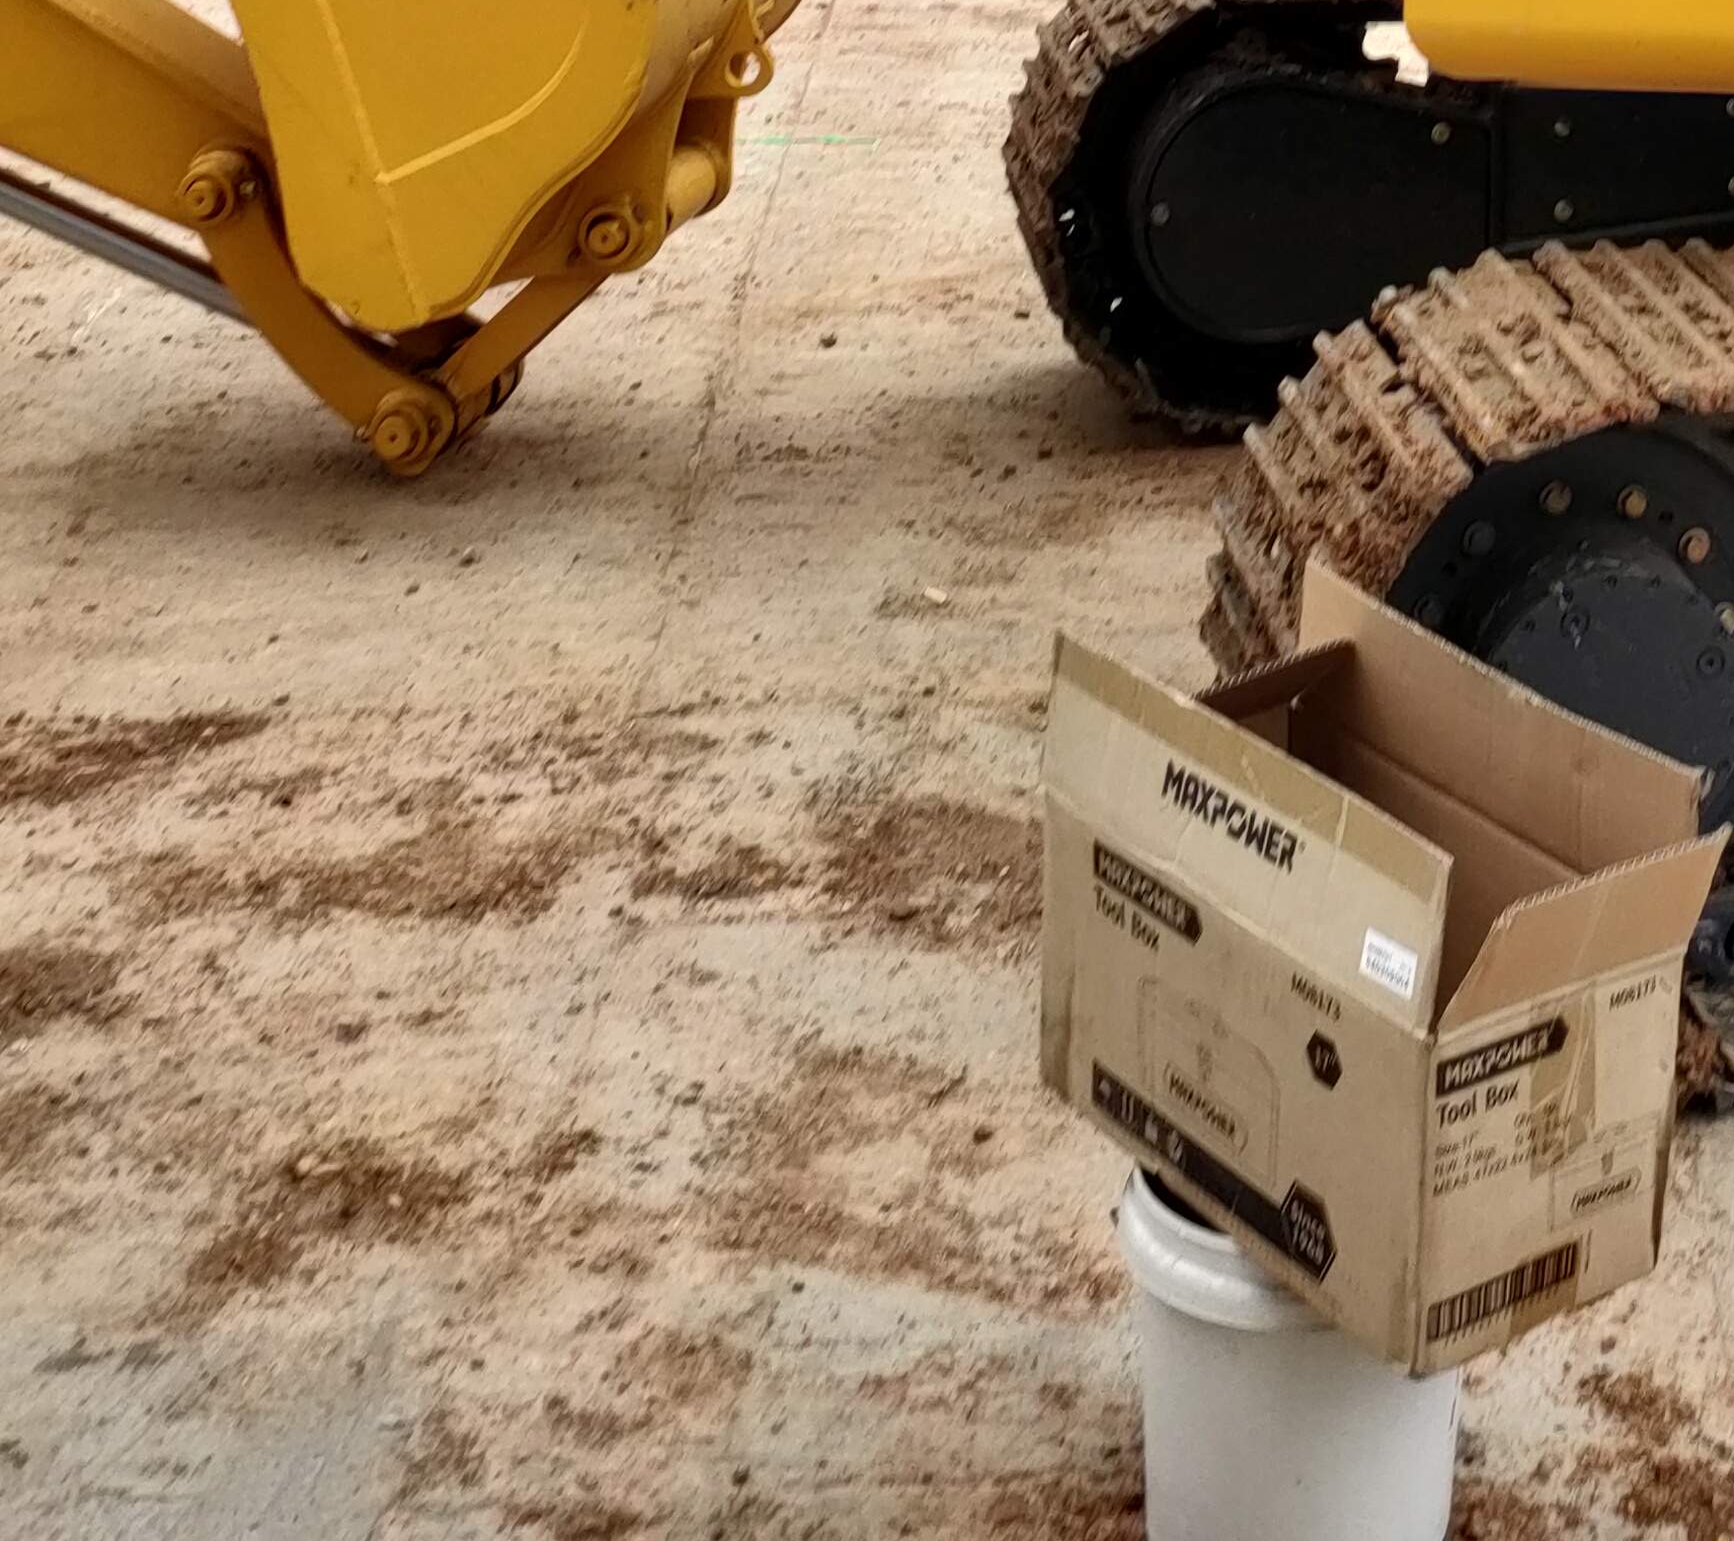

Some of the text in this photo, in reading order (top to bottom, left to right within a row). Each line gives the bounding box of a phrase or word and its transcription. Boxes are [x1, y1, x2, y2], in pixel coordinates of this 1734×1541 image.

[1160, 759, 1299, 875] MAXPOWER
[1094, 883, 1160, 953] Tool Box
[1436, 1091, 1477, 1129] Tool
[1485, 1077, 1520, 1112] Box
